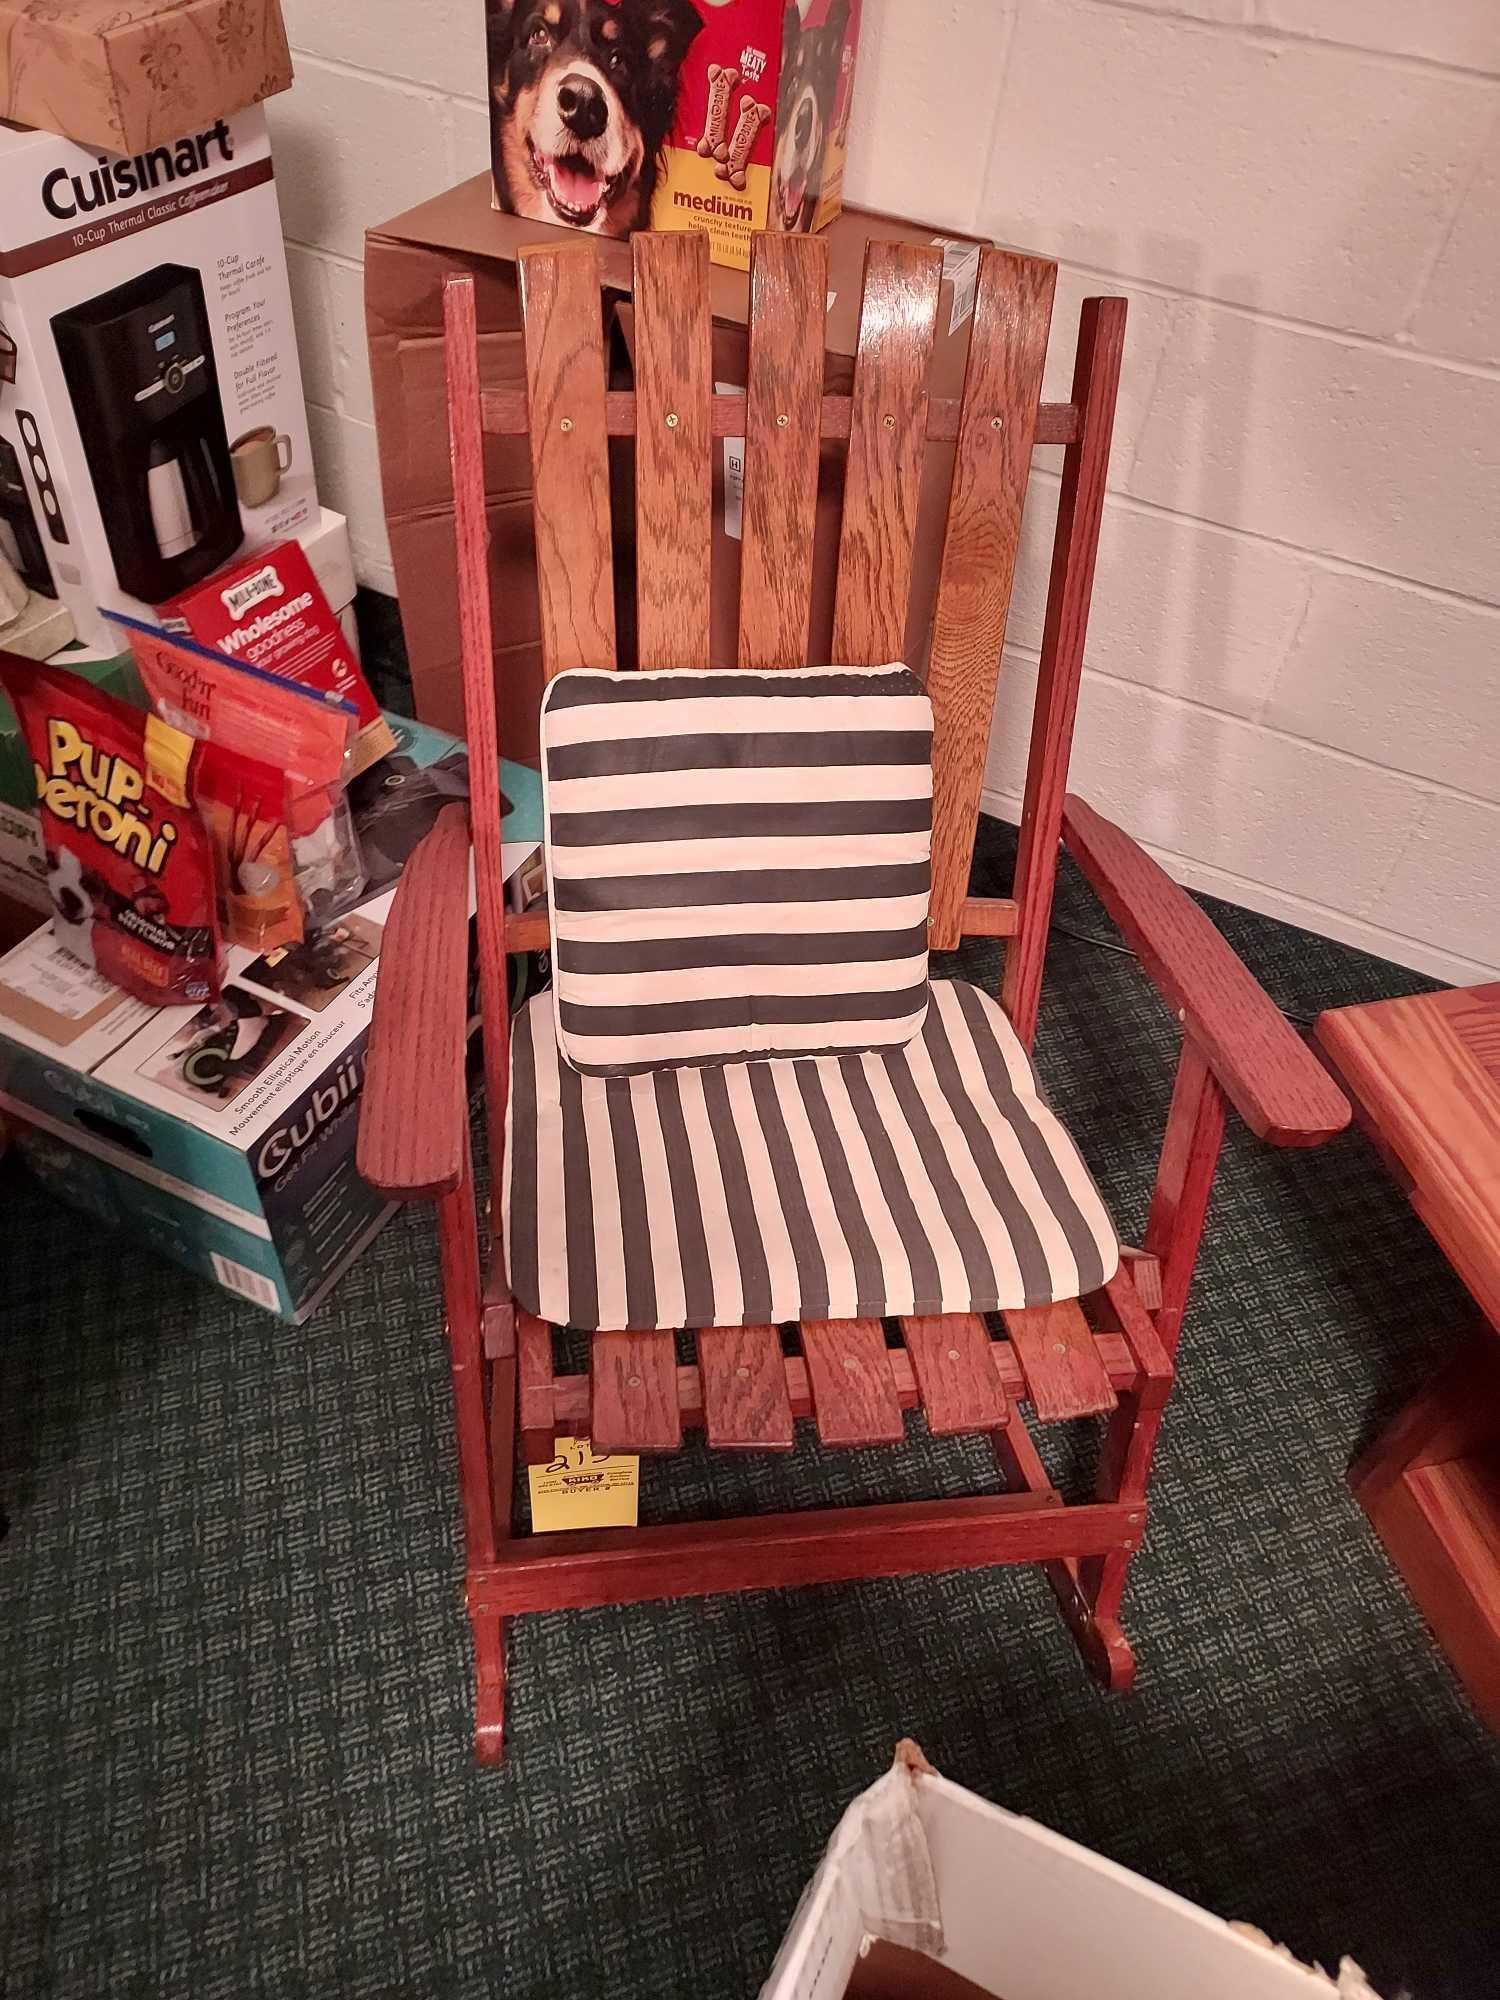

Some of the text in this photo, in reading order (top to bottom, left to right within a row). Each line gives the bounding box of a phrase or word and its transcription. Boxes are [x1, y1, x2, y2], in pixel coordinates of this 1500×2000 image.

[740, 49, 766, 73] MEATY
[41, 120, 234, 220] Cuisinart
[673, 191, 753, 221] medium
[72, 224, 106, 247] 10-Cup
[107, 210, 146, 236] Thermal
[147, 200, 177, 220] Classic
[693, 215, 752, 233] crunchy texture
[709, 227, 730, 237] clean
[217, 254, 239, 269] 10-Cup
[218, 263, 244, 281] Thermal
[225, 305, 251, 322] Program
[227, 313, 261, 333] Preferences
[216, 592, 313, 655] Wholesome
[246, 618, 306, 663] goodness
[229, 1020, 346, 1136] Mouvement elliptique en douceur
[235, 1030, 321, 1114] Smooth Elliptical Motion
